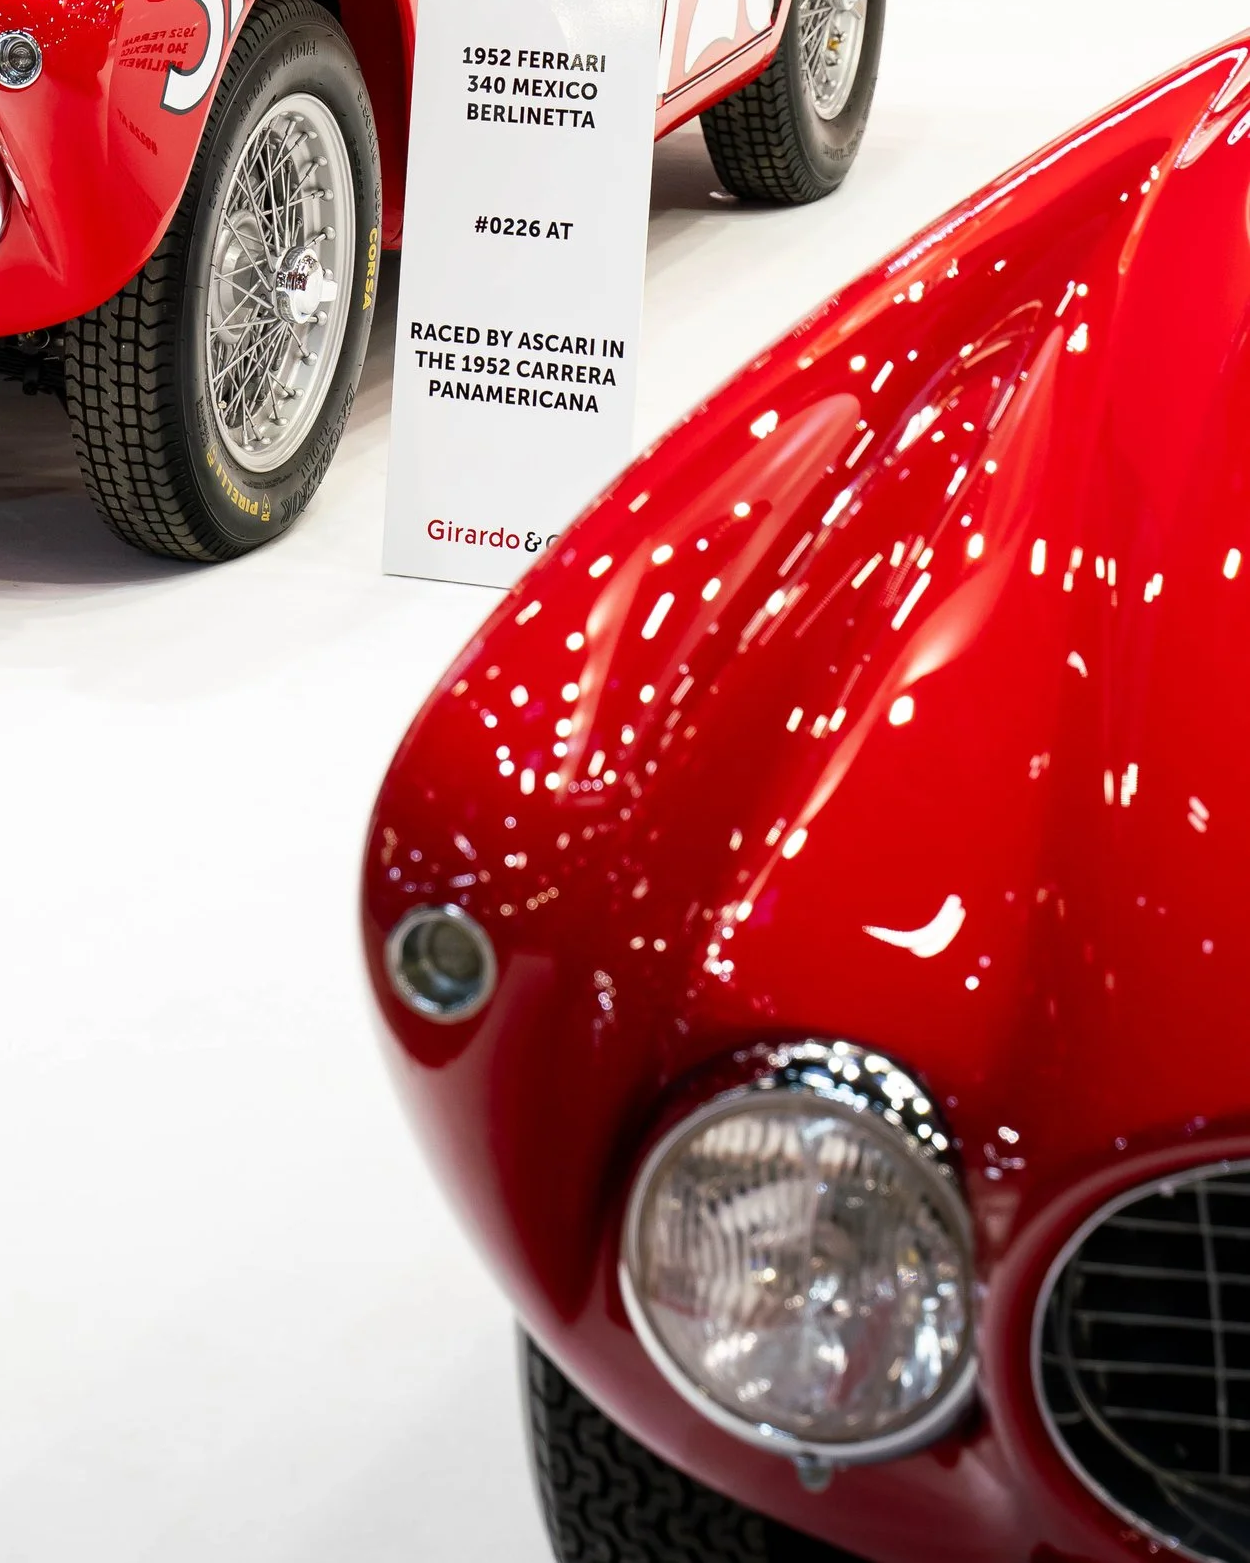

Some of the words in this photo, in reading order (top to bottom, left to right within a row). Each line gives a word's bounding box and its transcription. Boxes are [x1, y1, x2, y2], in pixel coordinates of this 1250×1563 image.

[462, 46, 511, 66] 1952
[517, 50, 606, 71] FERRARI
[466, 75, 506, 93] 340
[512, 78, 598, 99] MEXICO
[466, 103, 595, 128] BERLINETTA
[474, 215, 540, 237] #0226
[546, 221, 573, 239] AT
[362, 227, 378, 311] CORSA
[410, 321, 480, 343] RACED
[486, 328, 513, 347] BY
[518, 332, 595, 354] ASCARI
[602, 339, 624, 357] IN
[415, 350, 455, 369] THE
[461, 354, 509, 375] 1952
[516, 360, 615, 385] CARRERA
[428, 380, 599, 412] PANAMERICANA
[215, 463, 259, 516] PIRELLI
